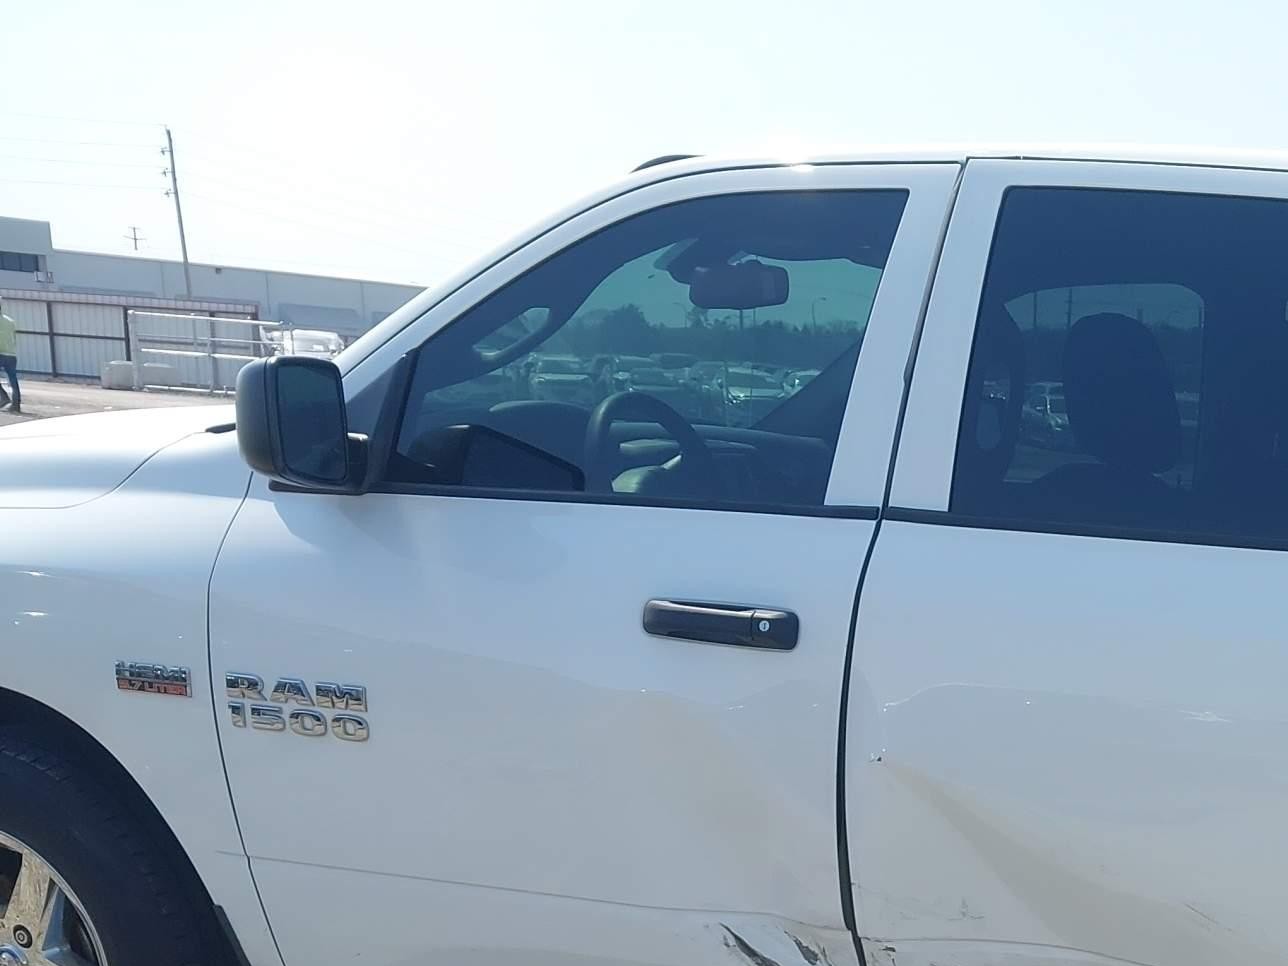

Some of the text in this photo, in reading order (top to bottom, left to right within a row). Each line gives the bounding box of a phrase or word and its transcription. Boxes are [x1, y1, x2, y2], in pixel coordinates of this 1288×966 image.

[115, 661, 189, 681] HEMI
[225, 672, 368, 712] RAM
[228, 701, 370, 741] 1500
